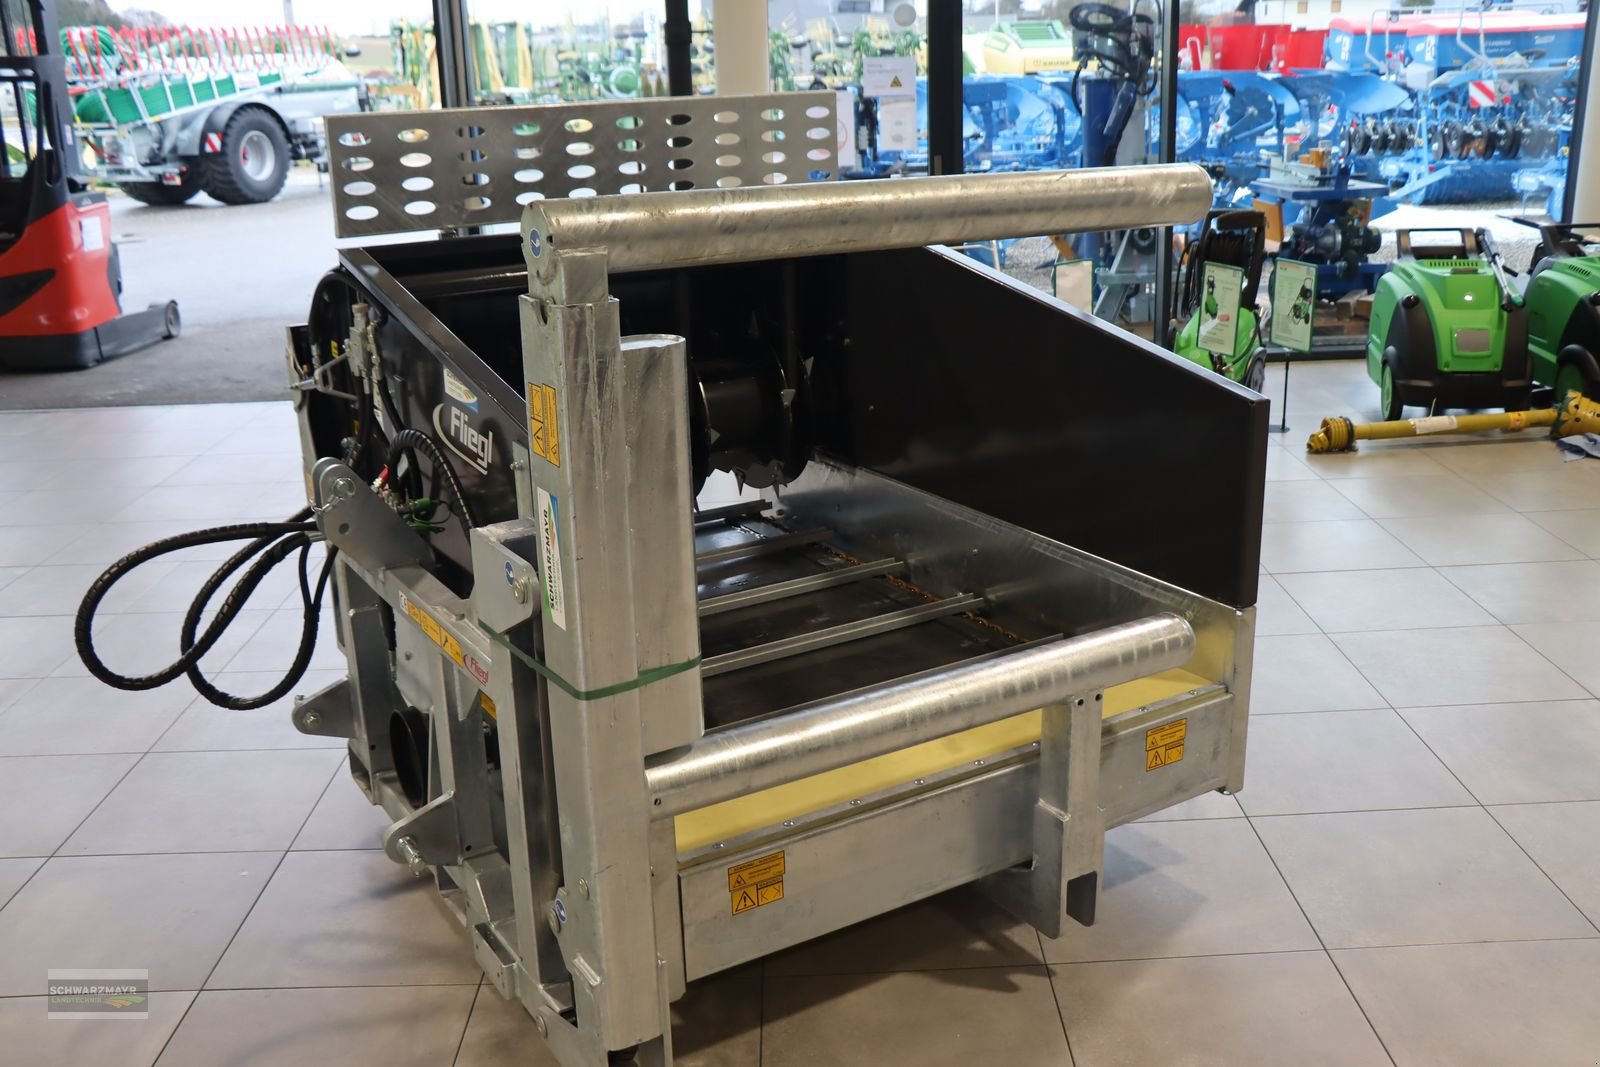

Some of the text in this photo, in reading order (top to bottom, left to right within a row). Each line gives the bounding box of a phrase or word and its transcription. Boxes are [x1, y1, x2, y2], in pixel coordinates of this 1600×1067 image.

[450, 406, 493, 469] Fliegl
[543, 509, 555, 610] SCHWARZMAYR
[470, 657, 489, 685] Fliegl
